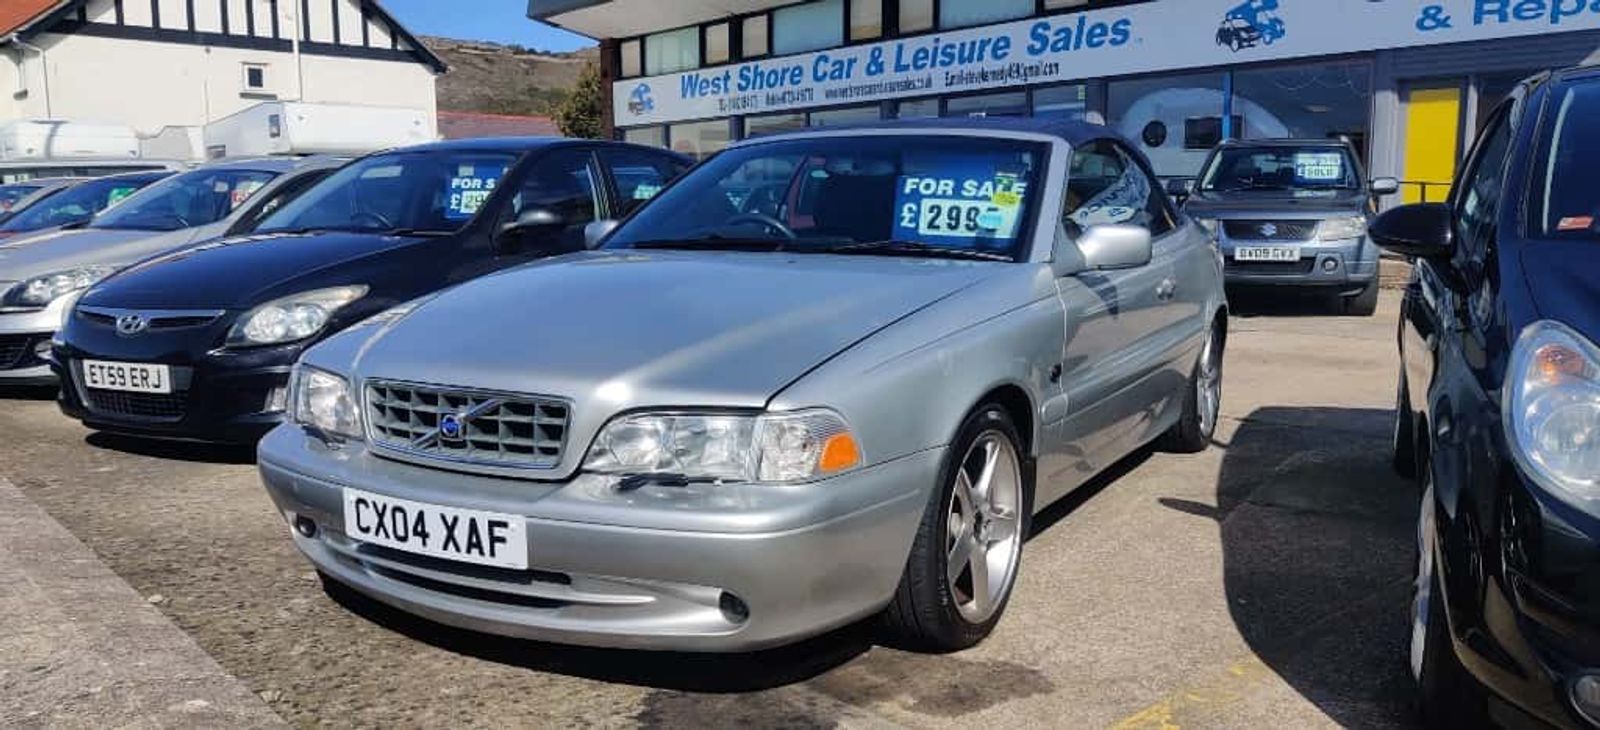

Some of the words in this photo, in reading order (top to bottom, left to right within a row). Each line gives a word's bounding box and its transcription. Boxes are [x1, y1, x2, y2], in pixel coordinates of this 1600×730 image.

[1416, 5, 1452, 31] &
[681, 70, 732, 98] West
[737, 63, 803, 91] Shore
[812, 54, 857, 83] Car
[866, 46, 884, 76] &
[894, 35, 1011, 74] Leisure
[1026, 15, 1132, 56] Sales
[451, 178, 482, 189] FOR
[904, 178, 955, 196] FOR
[88, 364, 126, 386] ET59
[130, 367, 161, 389] ERJ
[355, 498, 430, 547] CX04
[440, 513, 509, 558] XAF
